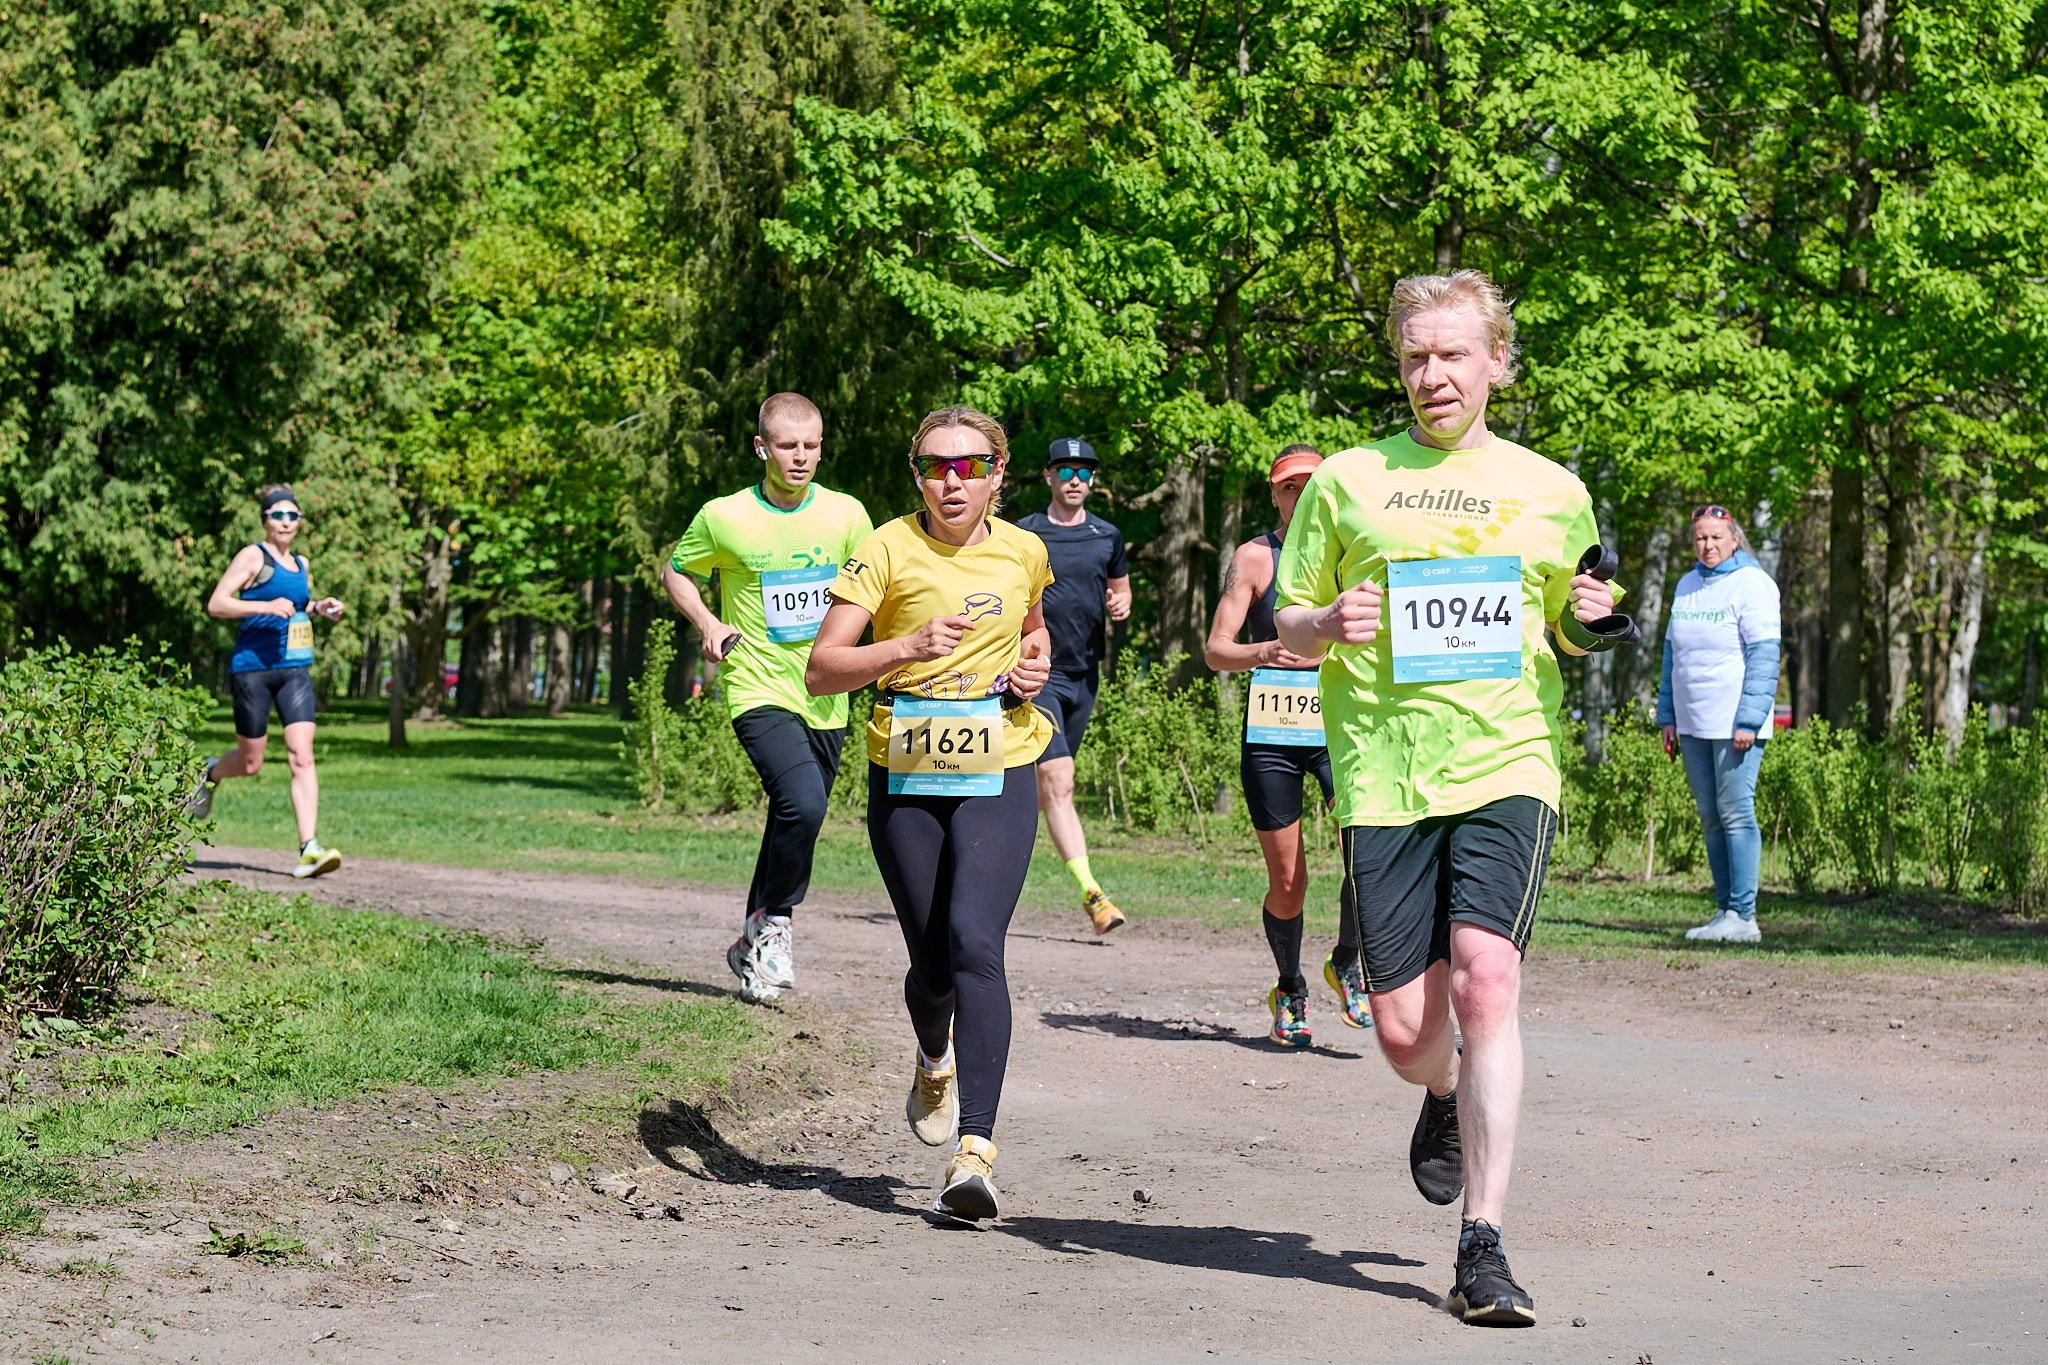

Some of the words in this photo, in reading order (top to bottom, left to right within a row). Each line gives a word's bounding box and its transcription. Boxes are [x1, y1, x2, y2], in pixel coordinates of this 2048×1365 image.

[1384, 489, 1492, 514] Achilles
[1423, 511, 1489, 521] INTERNATIONAL
[772, 587, 832, 612] 10918
[796, 614, 805, 622] 10
[1405, 596, 1511, 630] 10944
[1444, 636, 1460, 648] 10
[1461, 640, 1476, 648] км
[1258, 693, 1321, 714] 11198
[1279, 717, 1288, 725] 10
[902, 728, 989, 754] 11621
[932, 760, 946, 770] 10
